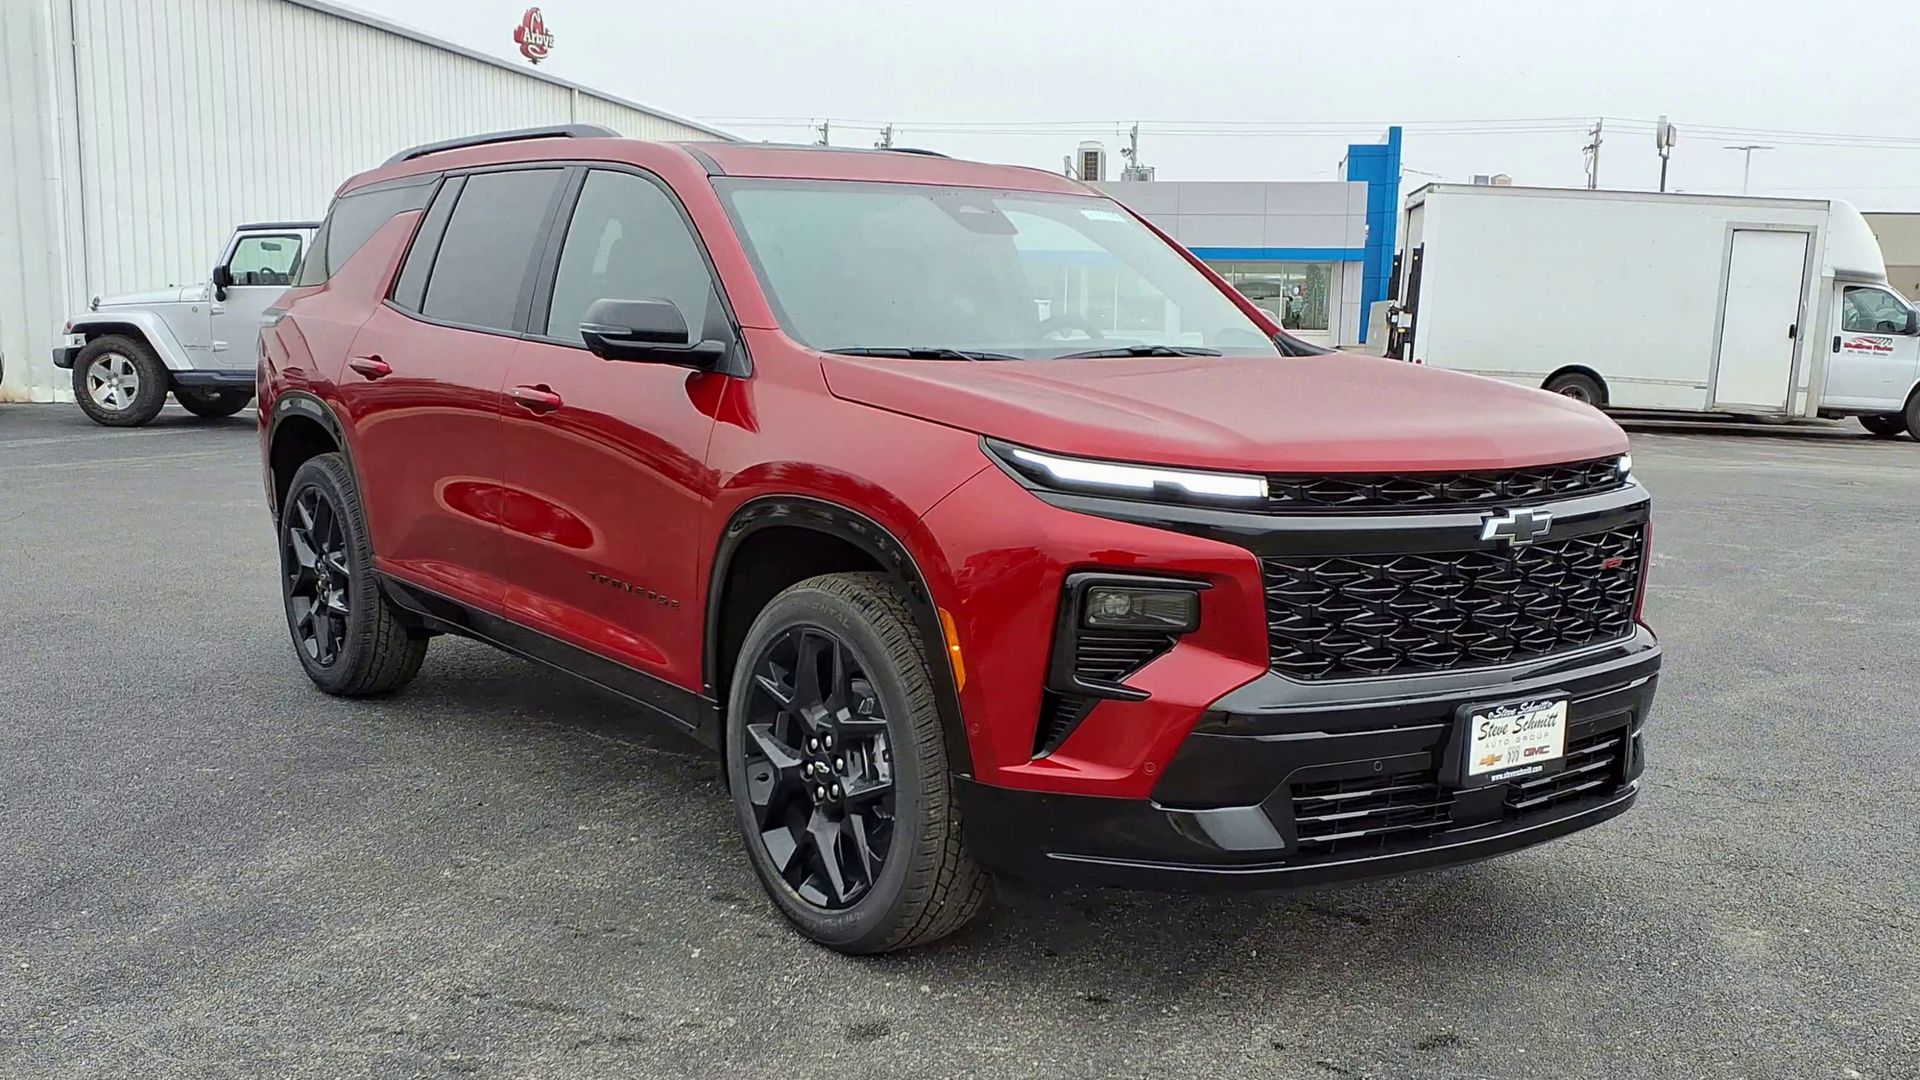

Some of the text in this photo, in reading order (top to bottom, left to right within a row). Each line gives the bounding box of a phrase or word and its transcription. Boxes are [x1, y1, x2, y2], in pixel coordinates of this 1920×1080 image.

[1477, 711, 1558, 741] Steve Schmitt
[1485, 738, 1510, 749] AUTO
[1515, 732, 1550, 743] GROUP
[1523, 745, 1550, 757] GMC
